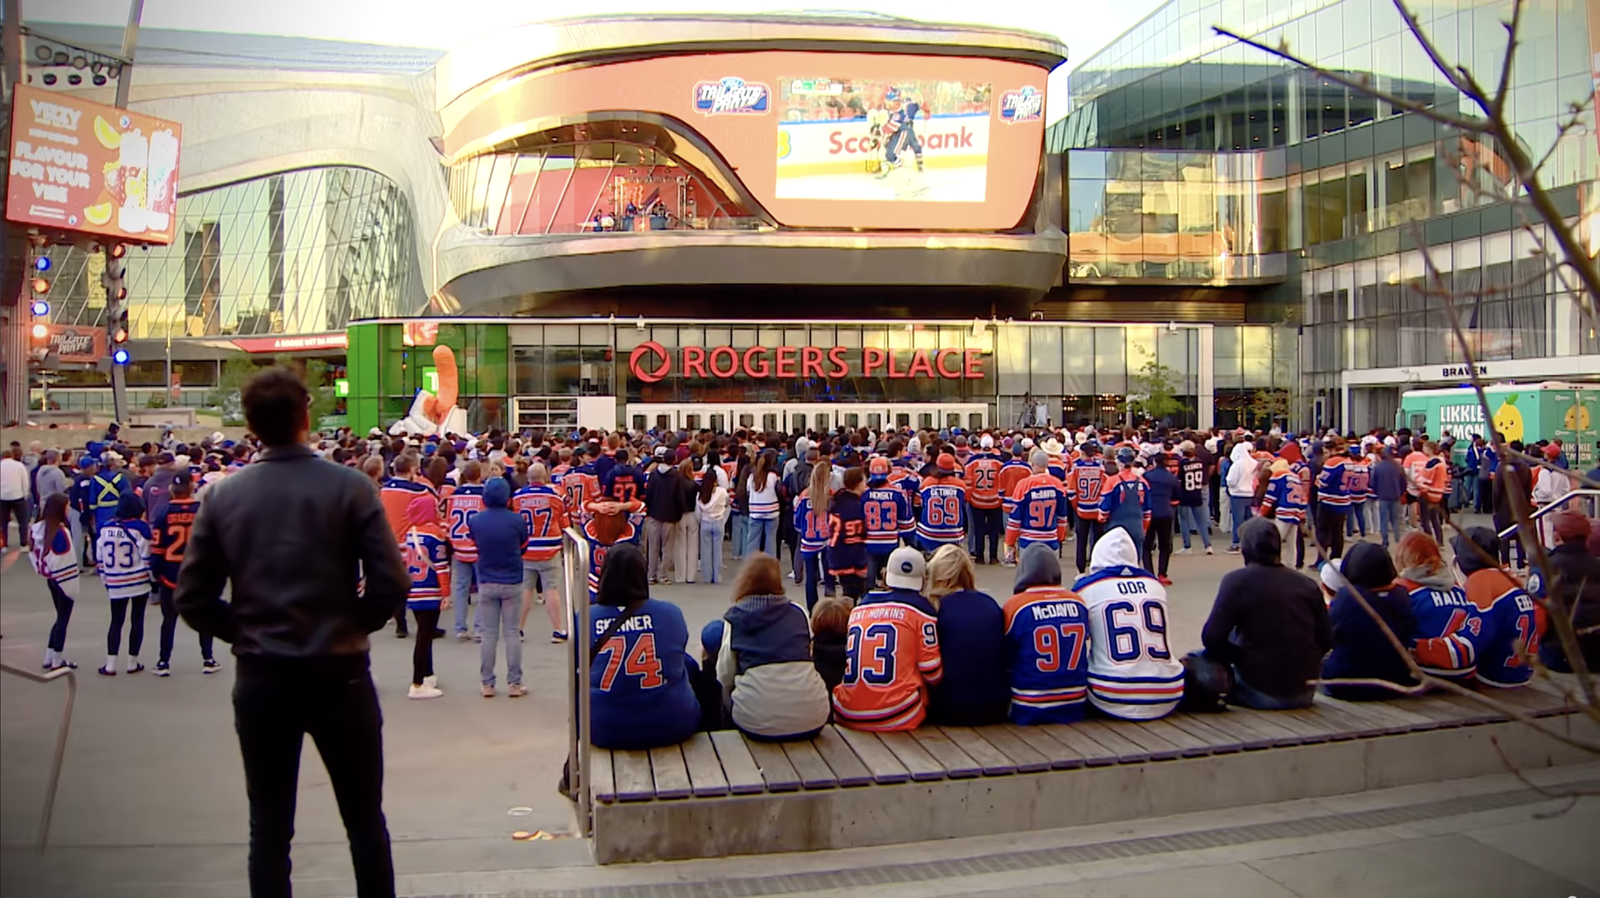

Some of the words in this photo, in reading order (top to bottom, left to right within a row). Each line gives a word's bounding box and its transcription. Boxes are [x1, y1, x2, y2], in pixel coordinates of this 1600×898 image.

[15, 141, 88, 170] FLAVOUR
[10, 159, 44, 180] FOR
[46, 166, 90, 189] YOUR
[682, 345, 848, 379] ROGERS
[863, 347, 985, 378] PLACE
[1440, 404, 1485, 422] LIKKLE
[975, 469, 996, 489] 25
[1078, 478, 1100, 500] 97
[1185, 471, 1203, 491] 89
[864, 501, 897, 530] 83
[928, 497, 960, 525] 69
[1029, 500, 1058, 528] 97
[104, 541, 134, 568] 33
[1117, 581, 1147, 594] ODR
[868, 608, 906, 620] HOPKINS
[1031, 602, 1079, 620] McDAVID
[922, 621, 938, 648] 9
[1102, 599, 1171, 665] 69
[842, 623, 898, 686] 93
[1033, 623, 1085, 672] 97
[598, 633, 663, 692] 74
